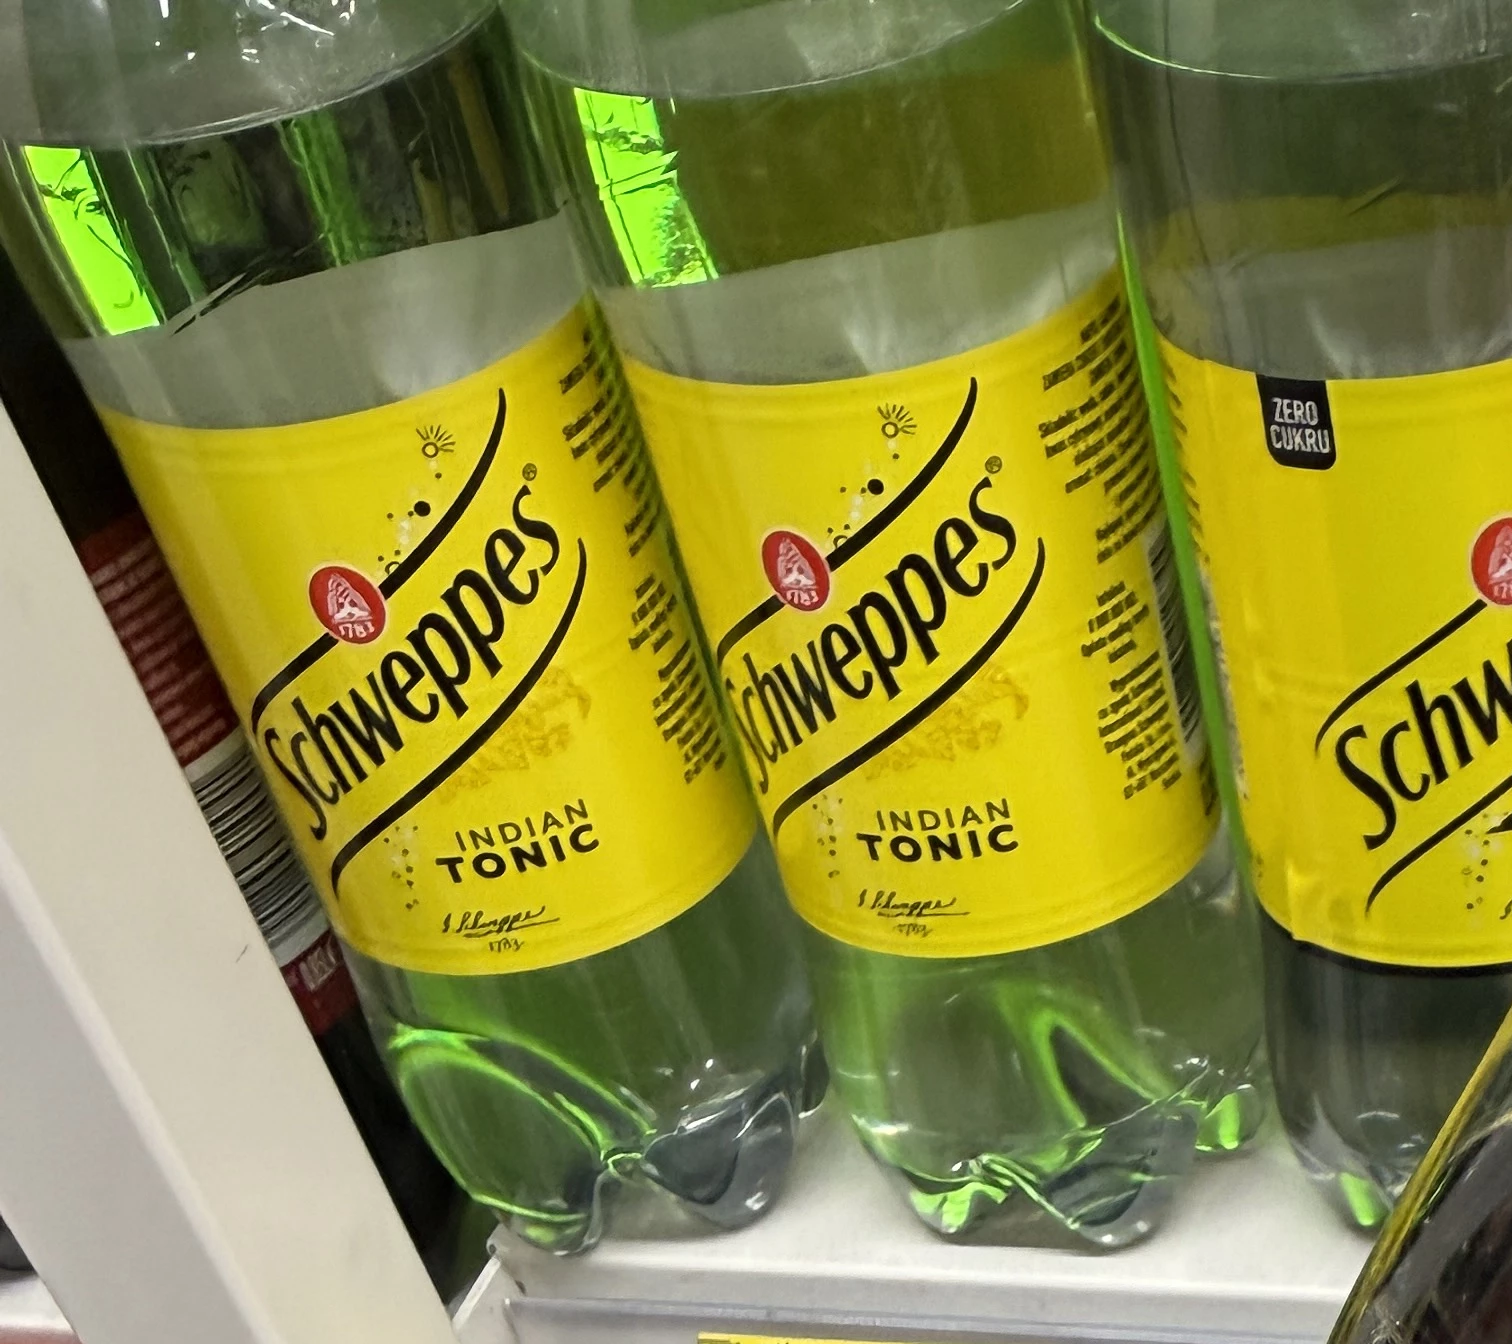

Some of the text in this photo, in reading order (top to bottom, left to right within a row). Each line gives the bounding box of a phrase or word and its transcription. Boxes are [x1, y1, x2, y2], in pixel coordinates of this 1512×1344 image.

[1272, 397, 1319, 426] ZERO
[1270, 424, 1331, 454] CUKRU
[725, 476, 1017, 795] Schweppes
[264, 484, 561, 841] Schweppes
[454, 799, 590, 851] INDIAN
[875, 798, 1012, 834] INDIAN
[435, 824, 600, 885] TONIC
[857, 824, 1020, 863] TONIC
